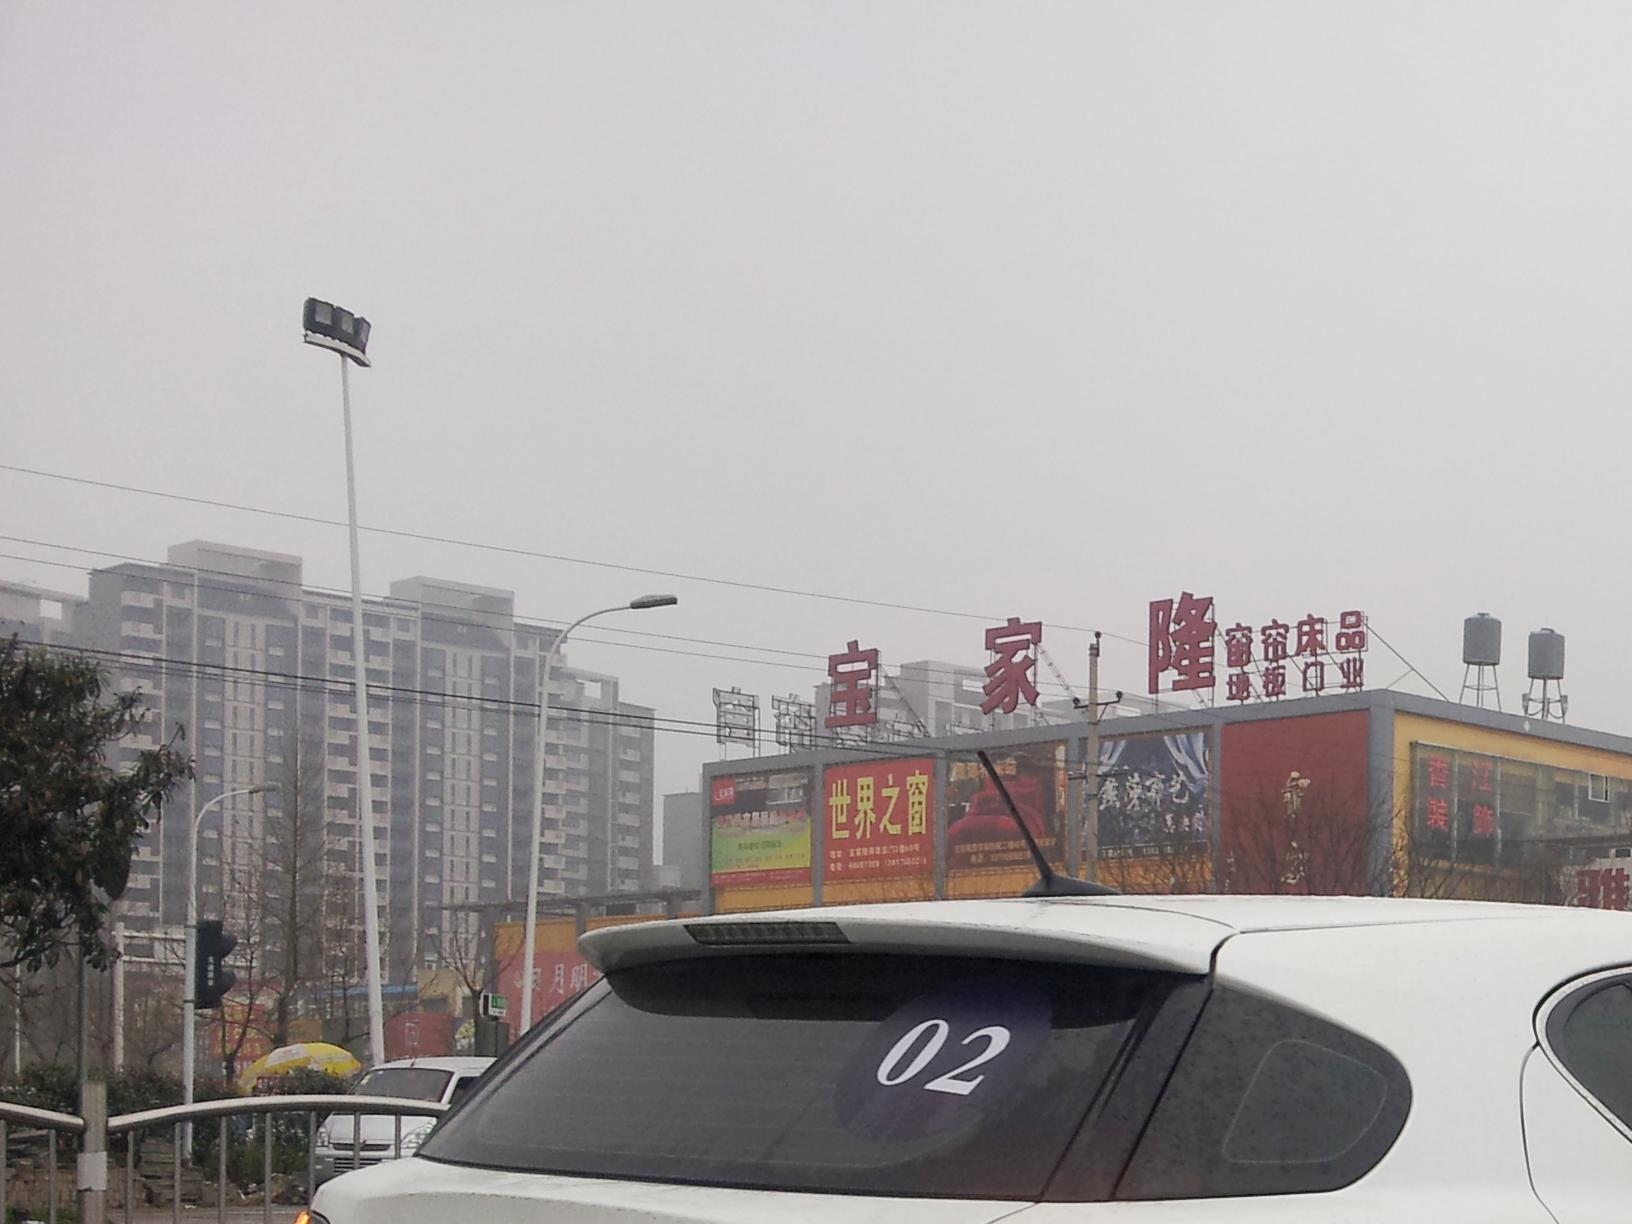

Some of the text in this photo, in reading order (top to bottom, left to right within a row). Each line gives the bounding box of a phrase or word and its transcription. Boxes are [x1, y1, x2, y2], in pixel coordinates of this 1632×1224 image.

[828, 769, 929, 841] 世界之窗
[877, 1019, 1011, 1096] 02
